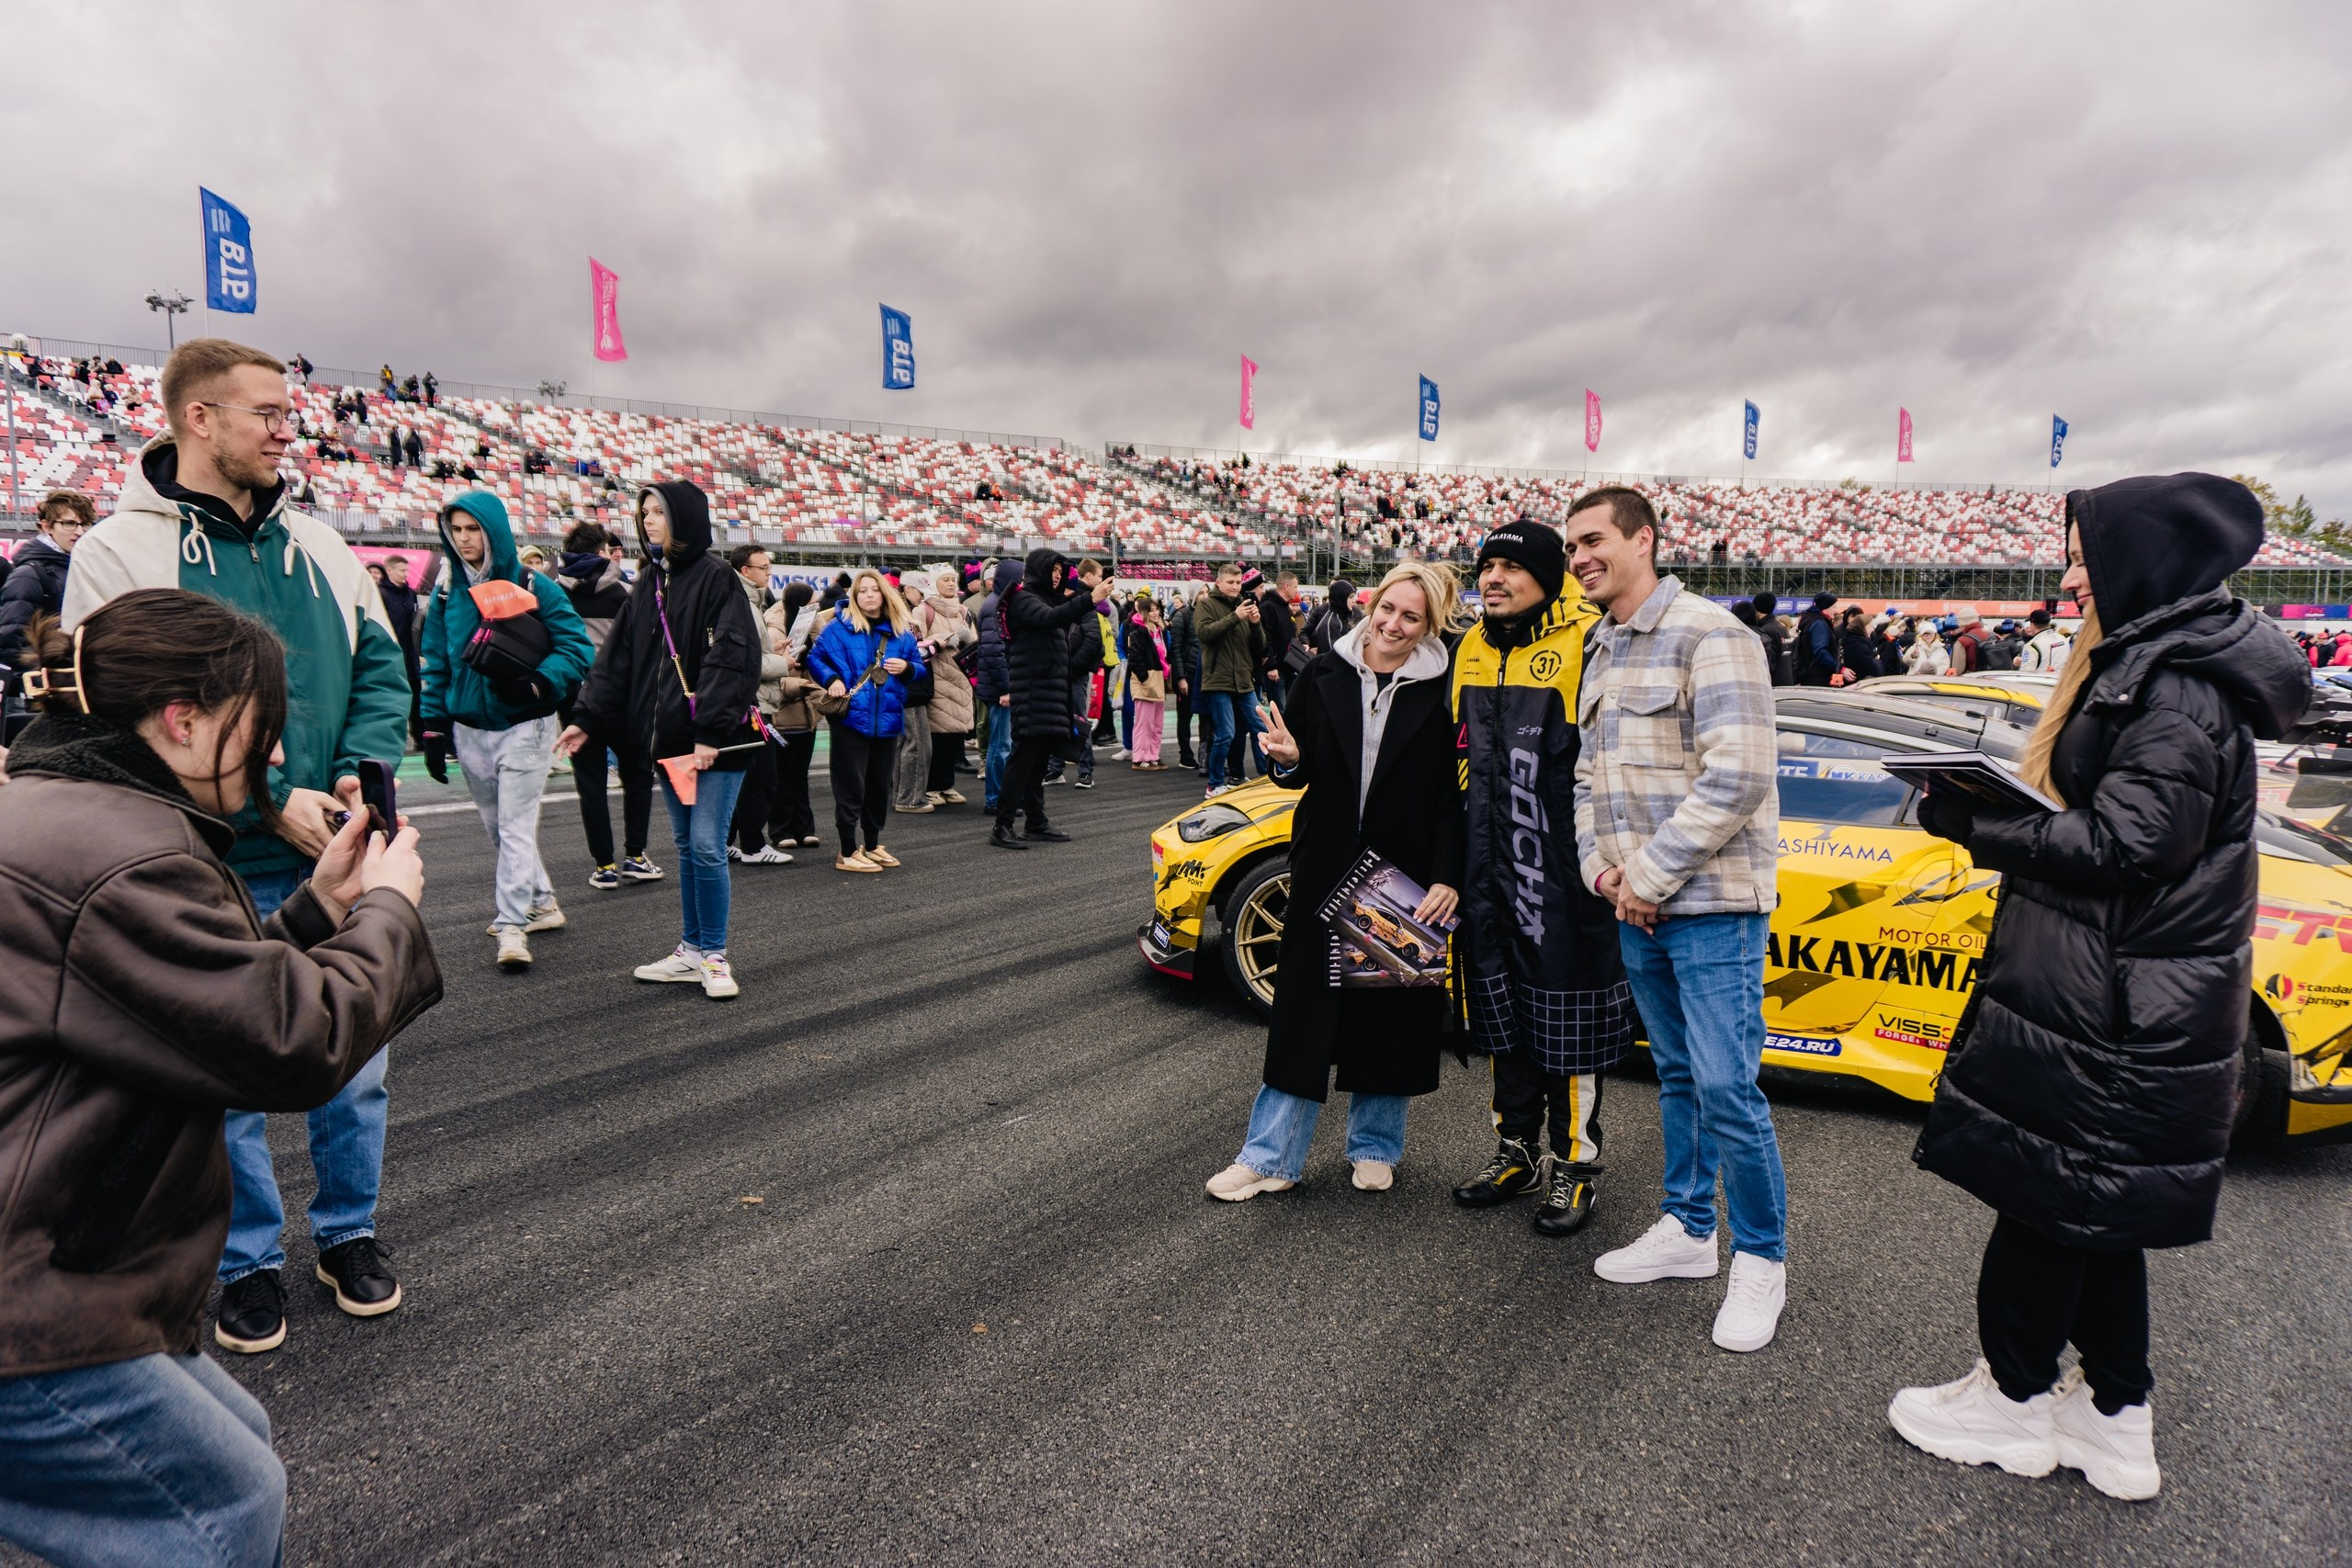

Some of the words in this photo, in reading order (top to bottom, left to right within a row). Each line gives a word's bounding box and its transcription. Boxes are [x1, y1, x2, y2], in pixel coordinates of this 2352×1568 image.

[771, 573, 837, 592] MSK1
[1536, 656, 1555, 675] 31
[1187, 876, 1204, 887] POINT
[1879, 926, 1951, 947] MOTOR
[1958, 934, 1986, 950] OIL
[2297, 994, 2350, 1009] Springs
[1763, 1035, 1835, 1054] E24.RU
